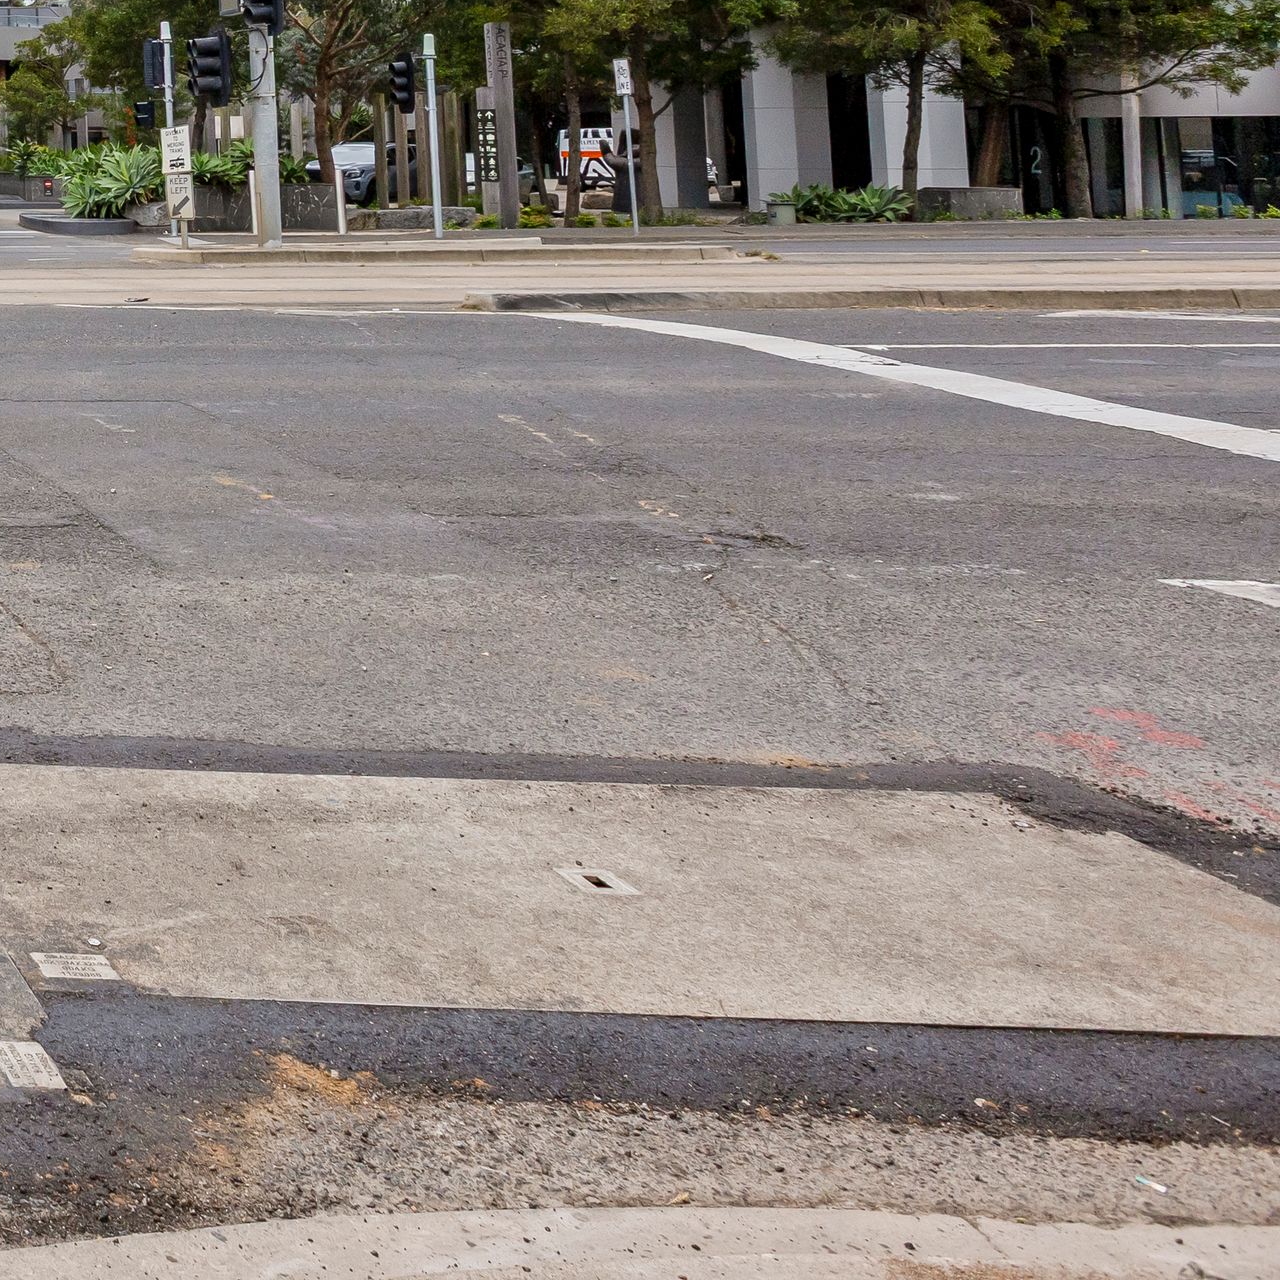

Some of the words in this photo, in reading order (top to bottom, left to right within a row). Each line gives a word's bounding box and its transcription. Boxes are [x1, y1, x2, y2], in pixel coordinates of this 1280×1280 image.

[496, 28, 508, 68] ACACIA
[1030, 146, 1042, 174] 2
[169, 177, 188, 185] KEEP
[170, 186, 188, 194] LEFT
